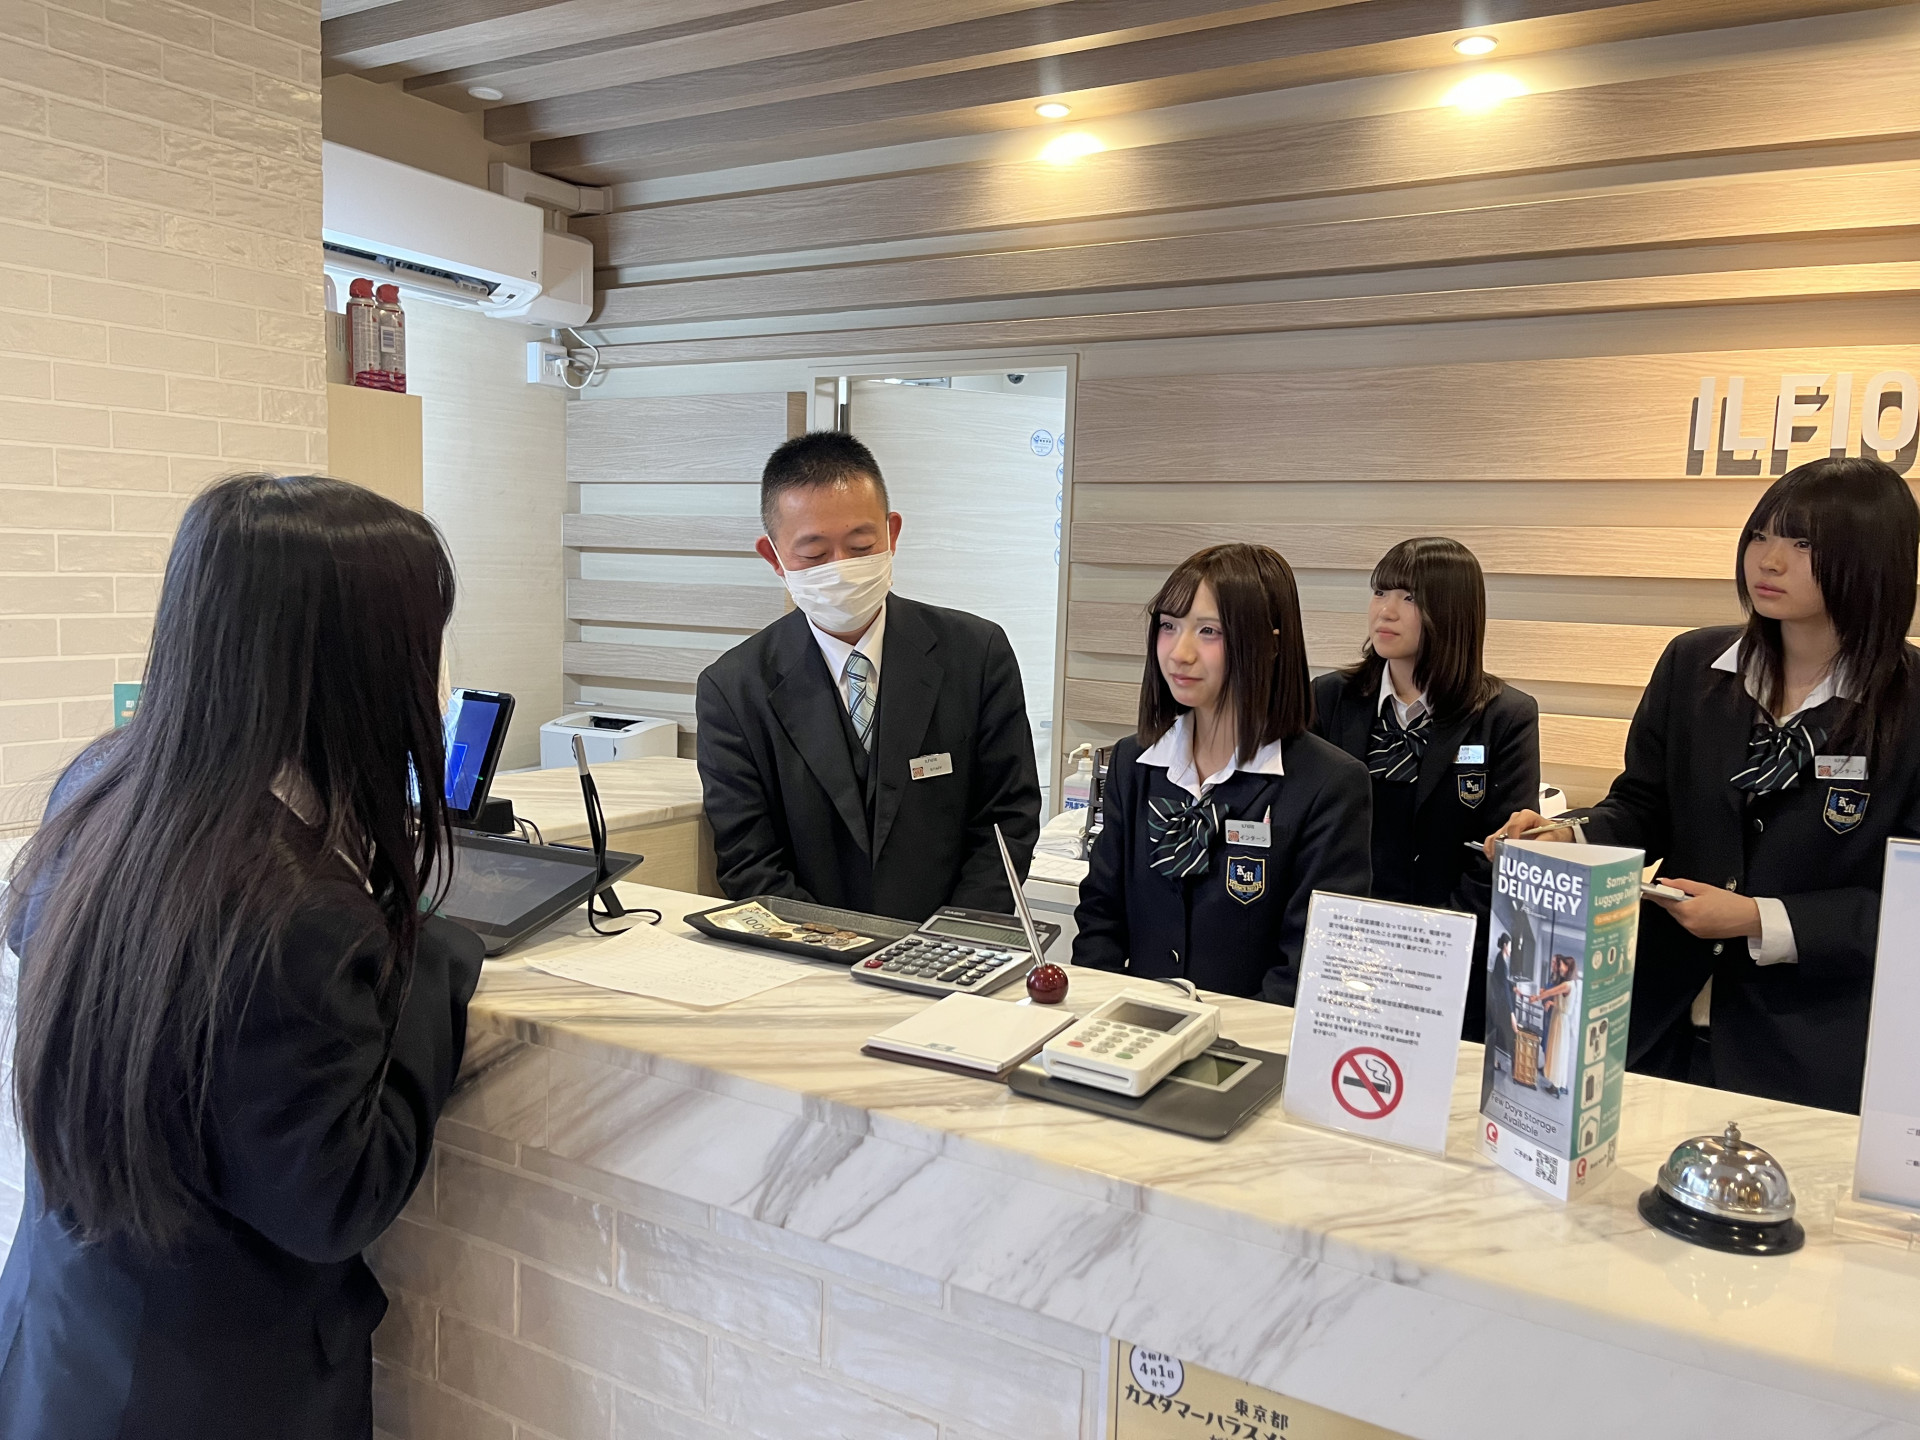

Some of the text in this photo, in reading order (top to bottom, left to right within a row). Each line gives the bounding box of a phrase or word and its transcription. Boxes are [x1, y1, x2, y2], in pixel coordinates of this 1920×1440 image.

[1240, 834, 1267, 842] インターン
[1499, 855, 1584, 897] LUGGAGE
[1497, 874, 1582, 916] DELIVERY
[1503, 1114, 1539, 1137] Available
[1504, 1101, 1523, 1118] Days
[1524, 1111, 1557, 1134] Storage
[1139, 1362, 1175, 1379] 4月1日
[1234, 1398, 1289, 1430] 東京都
